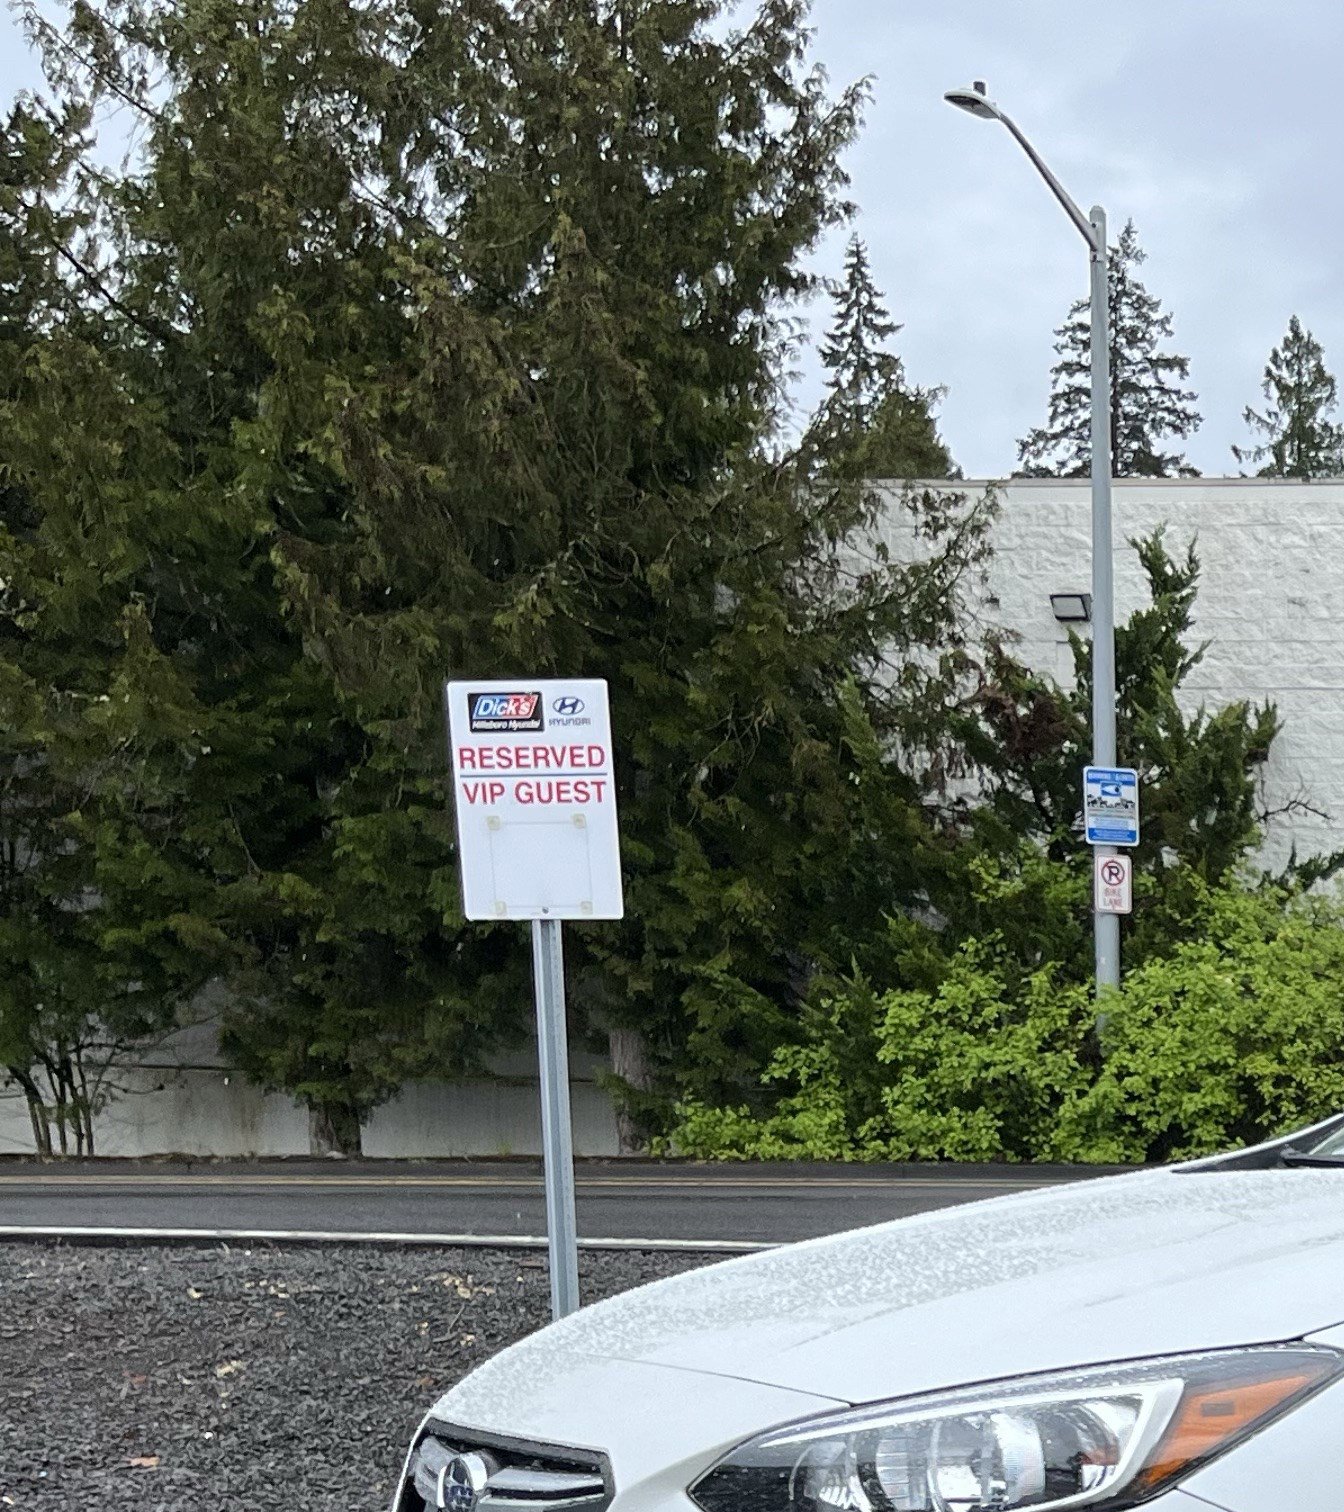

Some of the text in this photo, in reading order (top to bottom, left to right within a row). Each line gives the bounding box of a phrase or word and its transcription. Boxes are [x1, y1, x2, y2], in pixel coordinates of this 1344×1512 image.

[478, 698, 531, 716] Dick's
[459, 746, 605, 769] RESERVED
[463, 781, 606, 804] VIP GUEST
